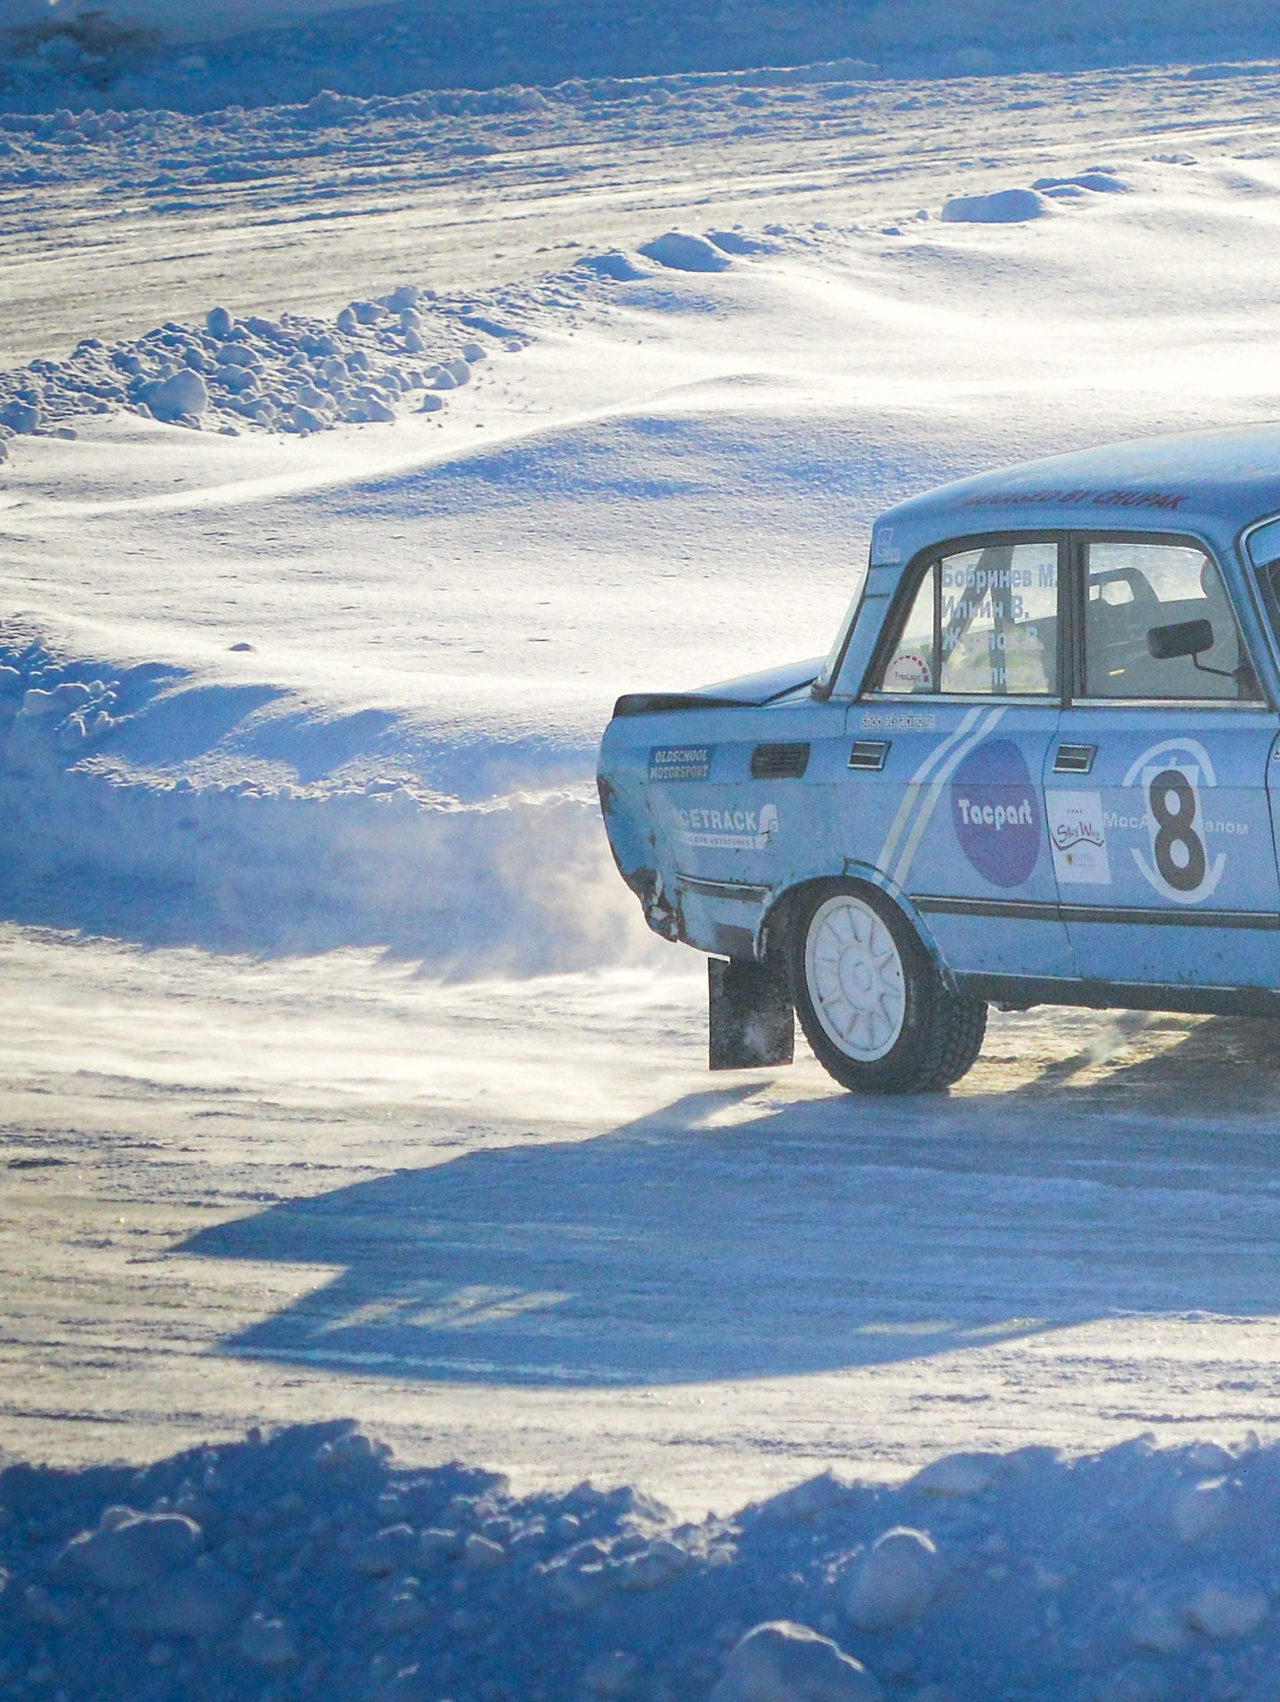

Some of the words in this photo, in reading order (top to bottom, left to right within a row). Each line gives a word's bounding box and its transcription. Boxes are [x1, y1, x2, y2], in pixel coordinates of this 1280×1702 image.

[654, 749, 708, 764] OLDSCHOOL
[650, 765, 709, 780] MOTORSPORT
[1149, 769, 1206, 892] 8
